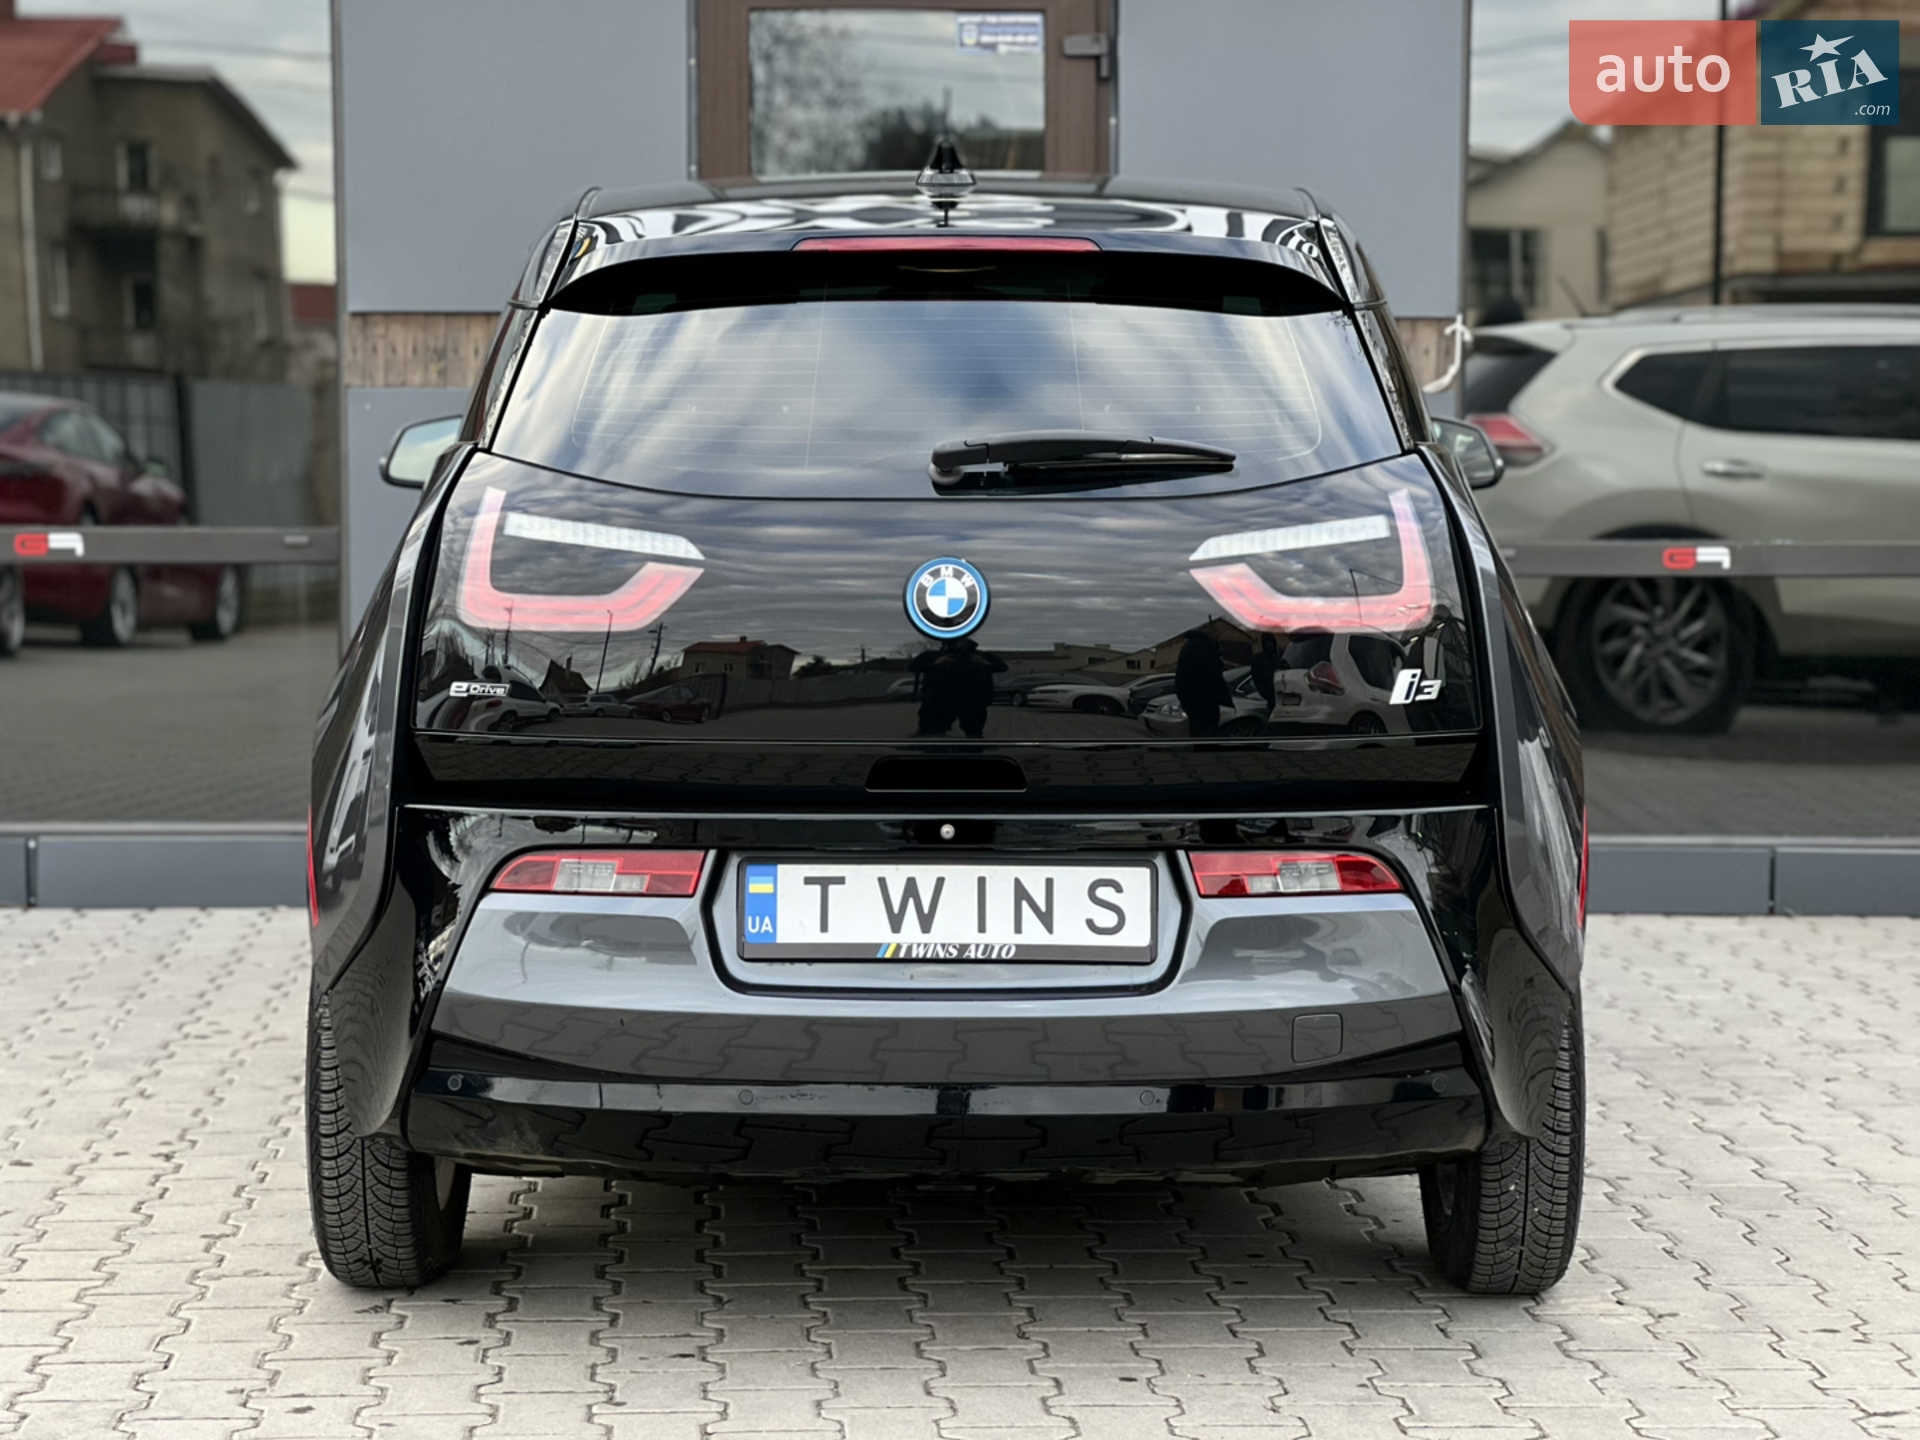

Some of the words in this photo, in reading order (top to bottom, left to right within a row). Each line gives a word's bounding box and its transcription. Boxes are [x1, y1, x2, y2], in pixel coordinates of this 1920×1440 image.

[919, 566, 975, 588] BMW
[1389, 668, 1442, 705] i3
[803, 875, 1127, 936] TWINS
[748, 915, 774, 933] UA
[898, 943, 960, 958] TWINS
[963, 943, 1017, 959] AUTO
